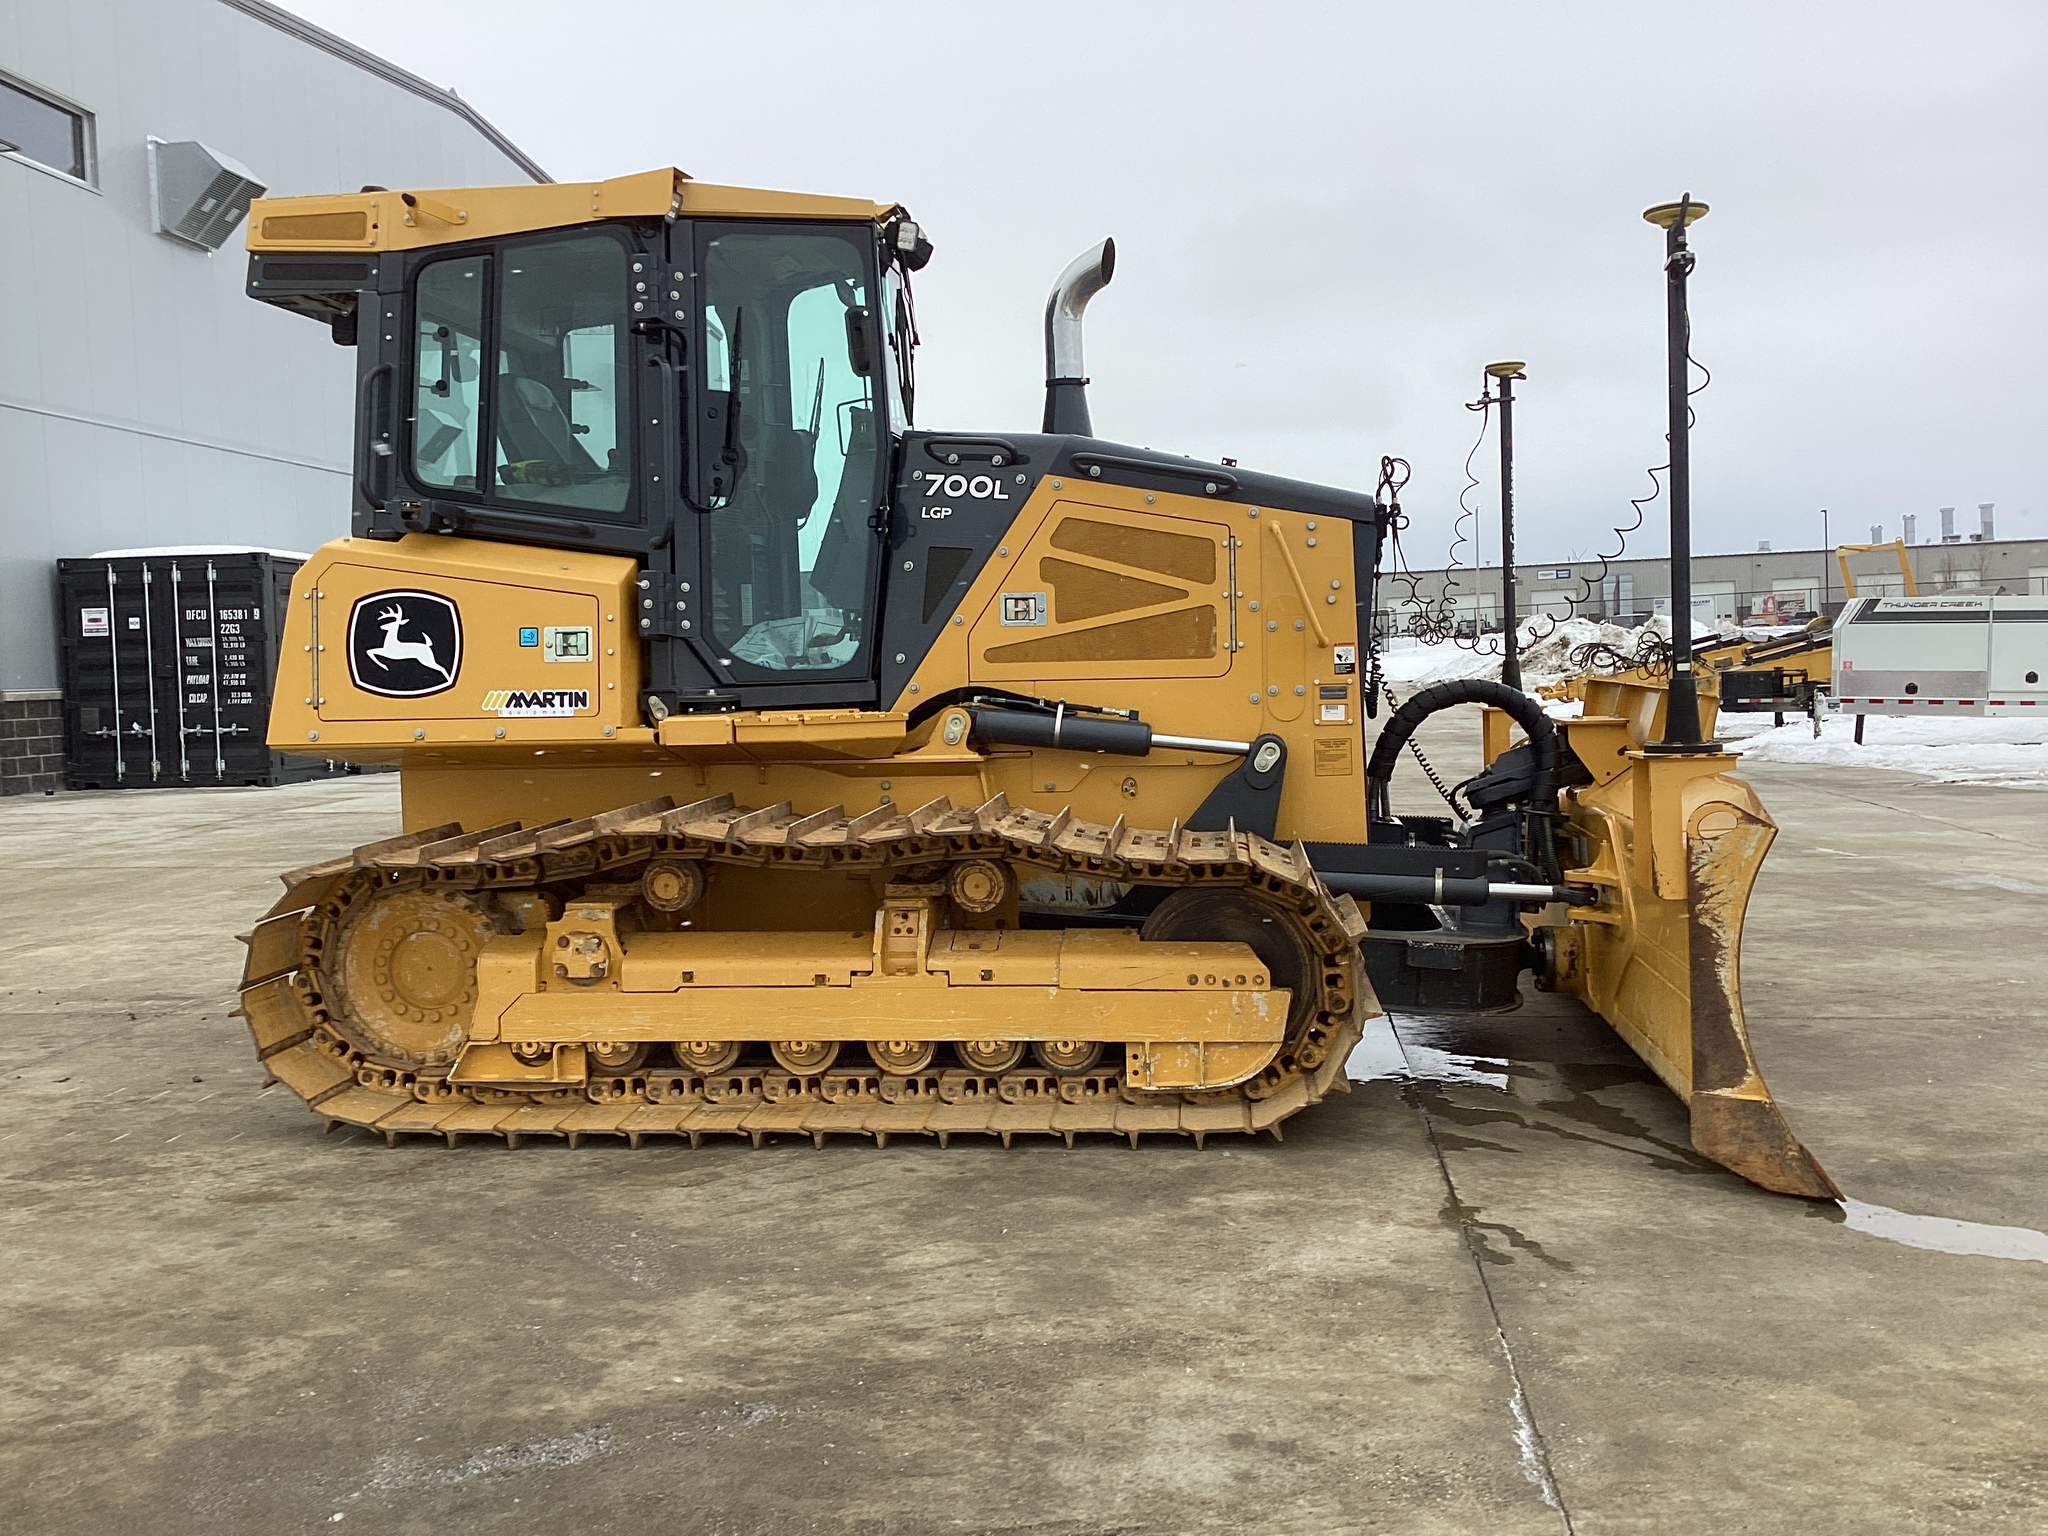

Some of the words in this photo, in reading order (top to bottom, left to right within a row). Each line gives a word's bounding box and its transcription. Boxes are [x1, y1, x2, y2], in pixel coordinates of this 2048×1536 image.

[925, 474, 1009, 500] 700L
[921, 506, 952, 519] LGP
[185, 609, 207, 620] DFCU
[219, 609, 248, 620] 165381
[253, 608, 260, 620] 9
[220, 623, 240, 634] 22G3
[186, 674, 210, 685] PAYLOAD
[505, 691, 588, 709] MARTIN
